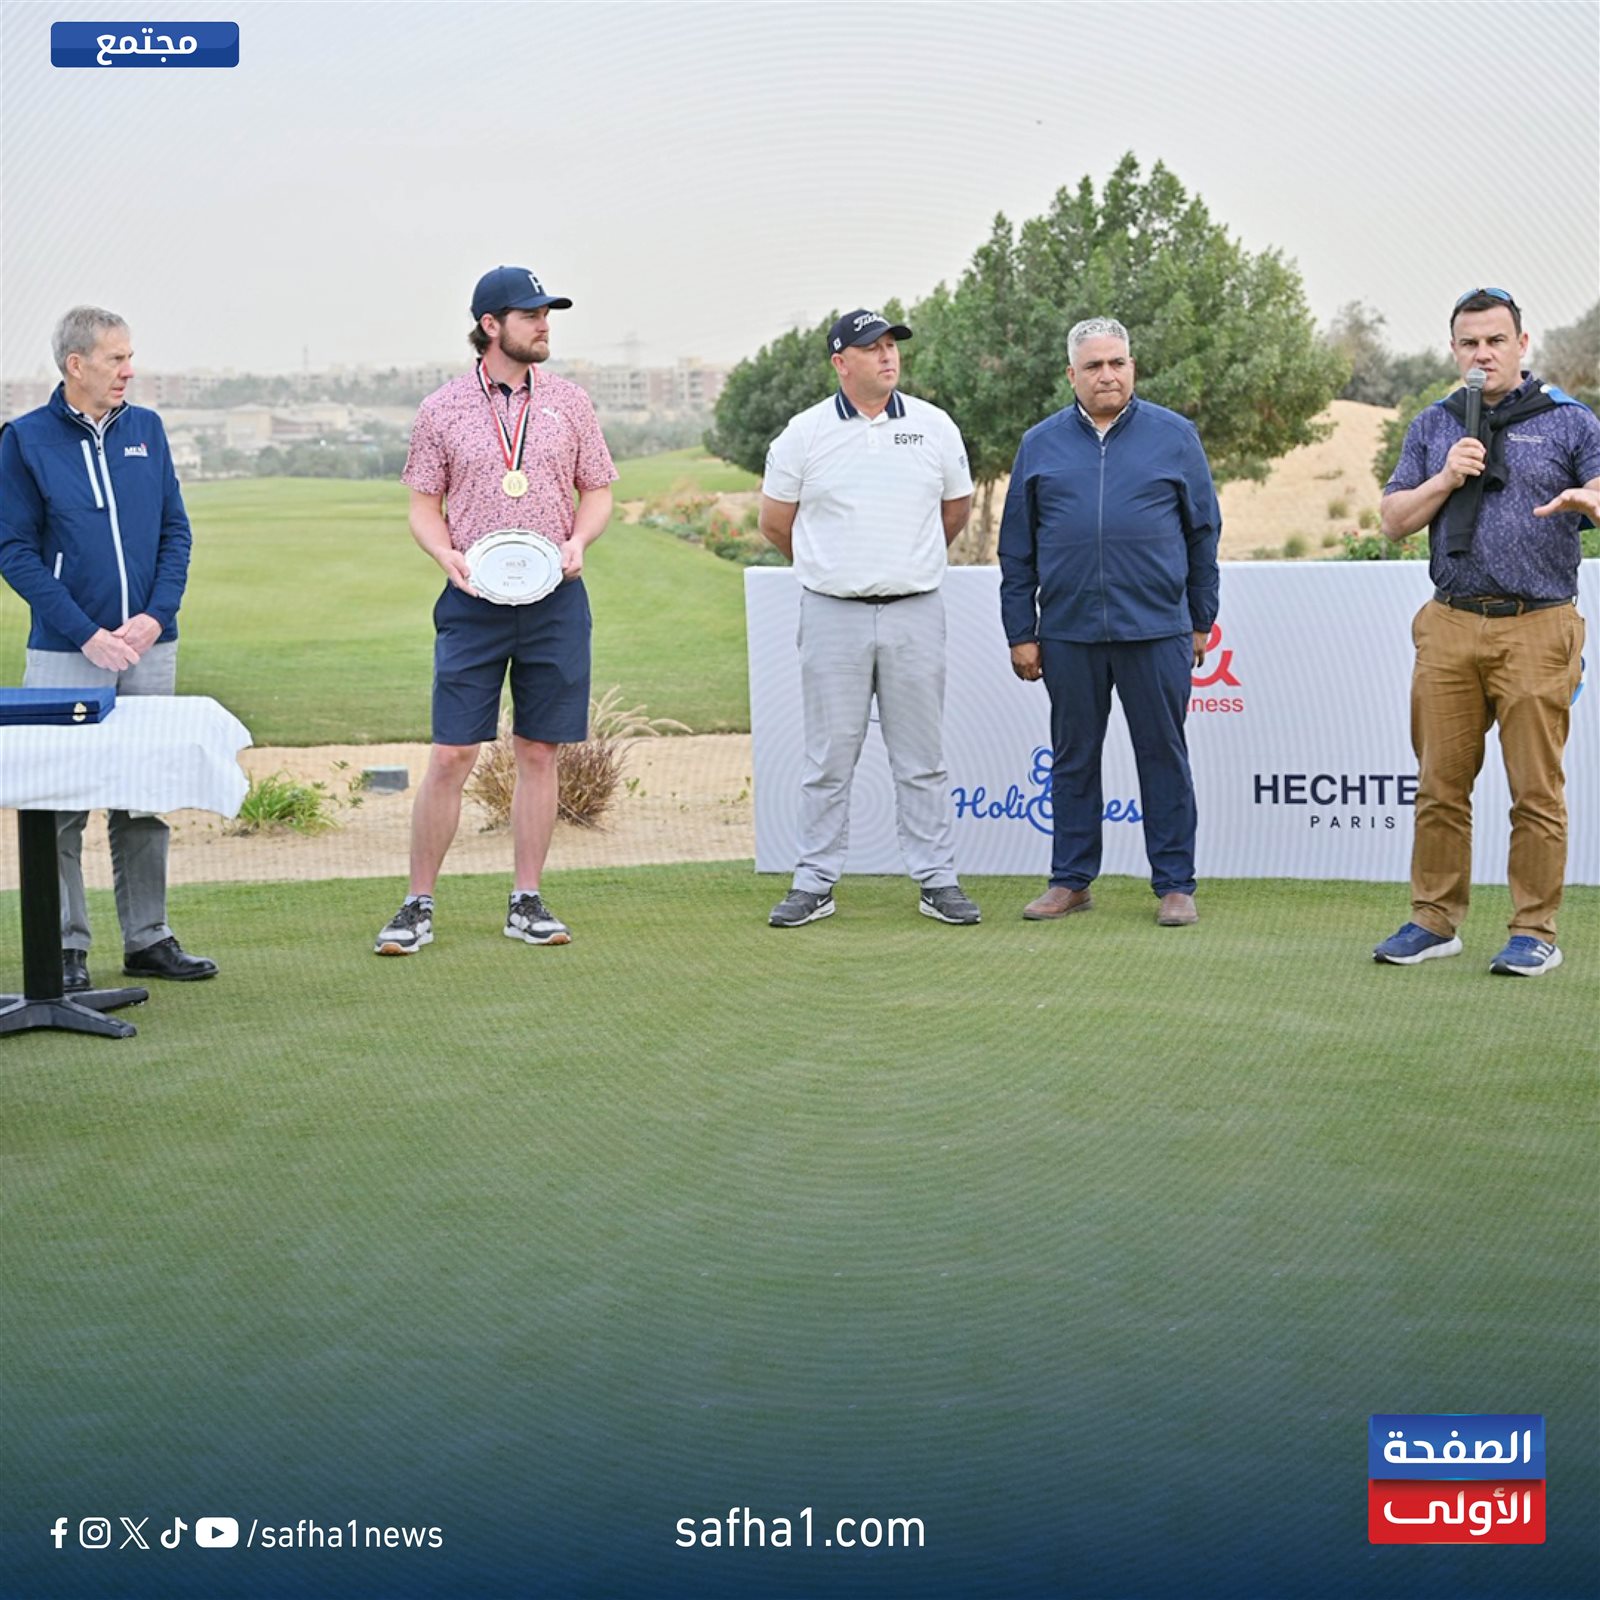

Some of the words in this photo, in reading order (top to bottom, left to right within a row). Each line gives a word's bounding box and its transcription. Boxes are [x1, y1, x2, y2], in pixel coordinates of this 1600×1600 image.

[894, 433, 925, 446] EGYPT
[1187, 697, 1244, 713] ness
[1253, 773, 1419, 806] HECHTE
[1310, 815, 1396, 830] PARIS
